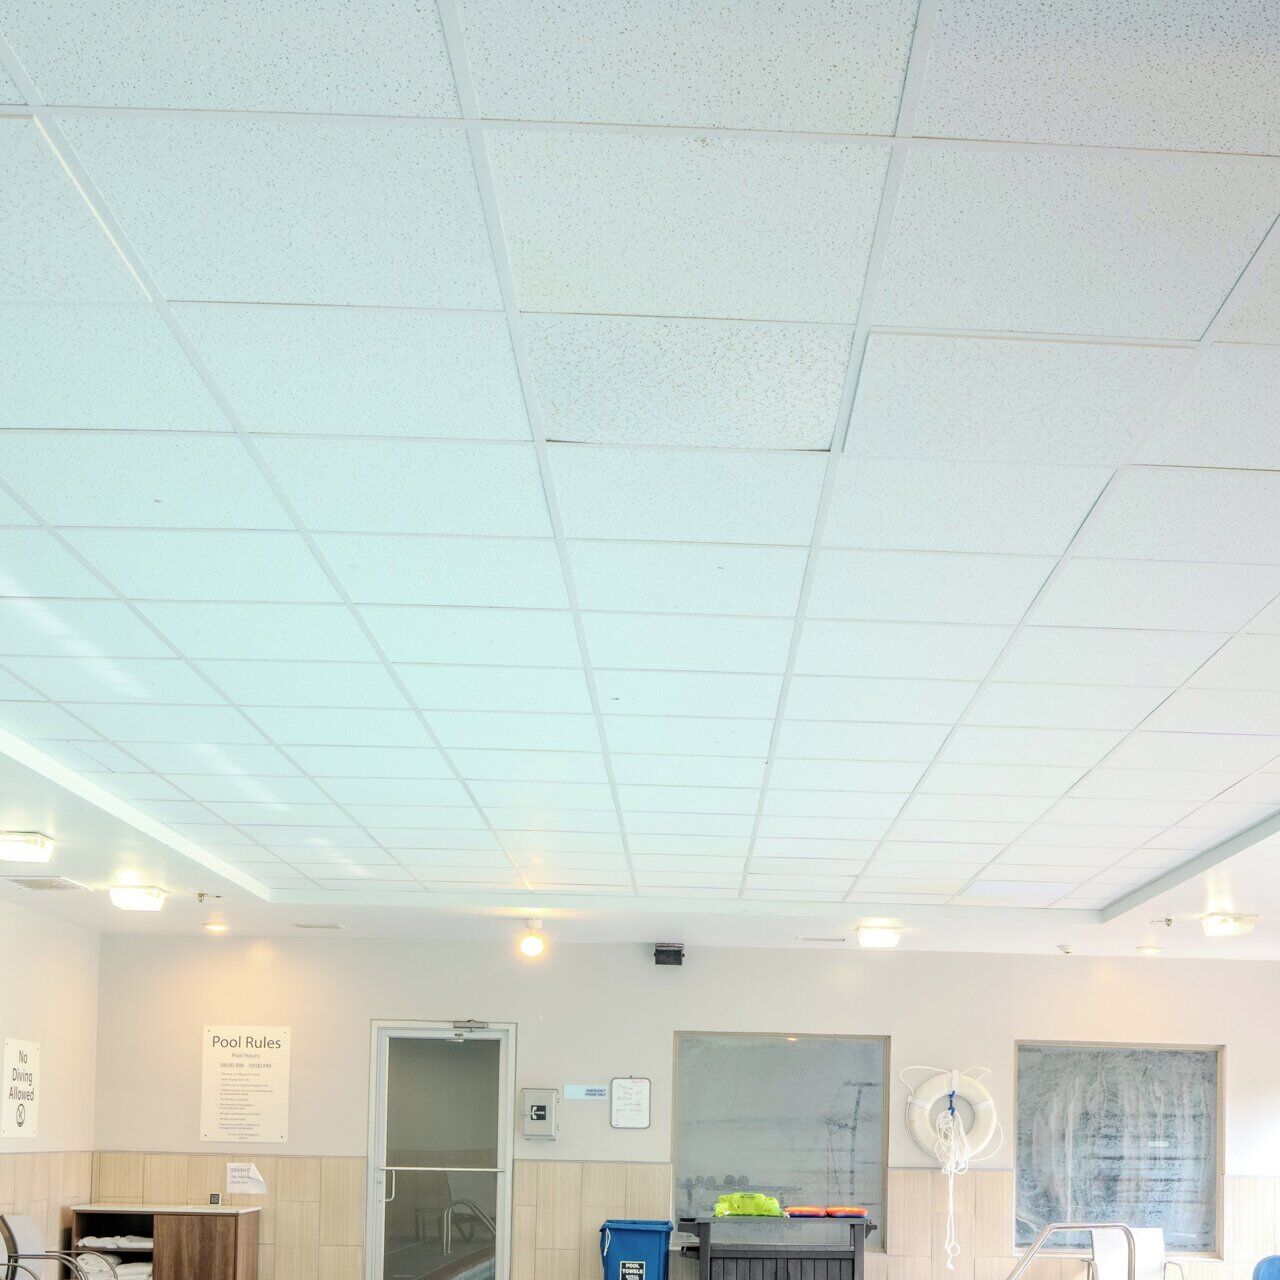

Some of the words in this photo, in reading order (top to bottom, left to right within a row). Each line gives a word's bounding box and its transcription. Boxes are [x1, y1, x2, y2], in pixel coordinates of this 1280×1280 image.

[212, 1035, 241, 1048] Pool
[245, 1036, 281, 1049] Rules
[18, 1050, 28, 1064] No
[12, 1067, 33, 1086] Diving
[9, 1086, 35, 1101] Allowed
